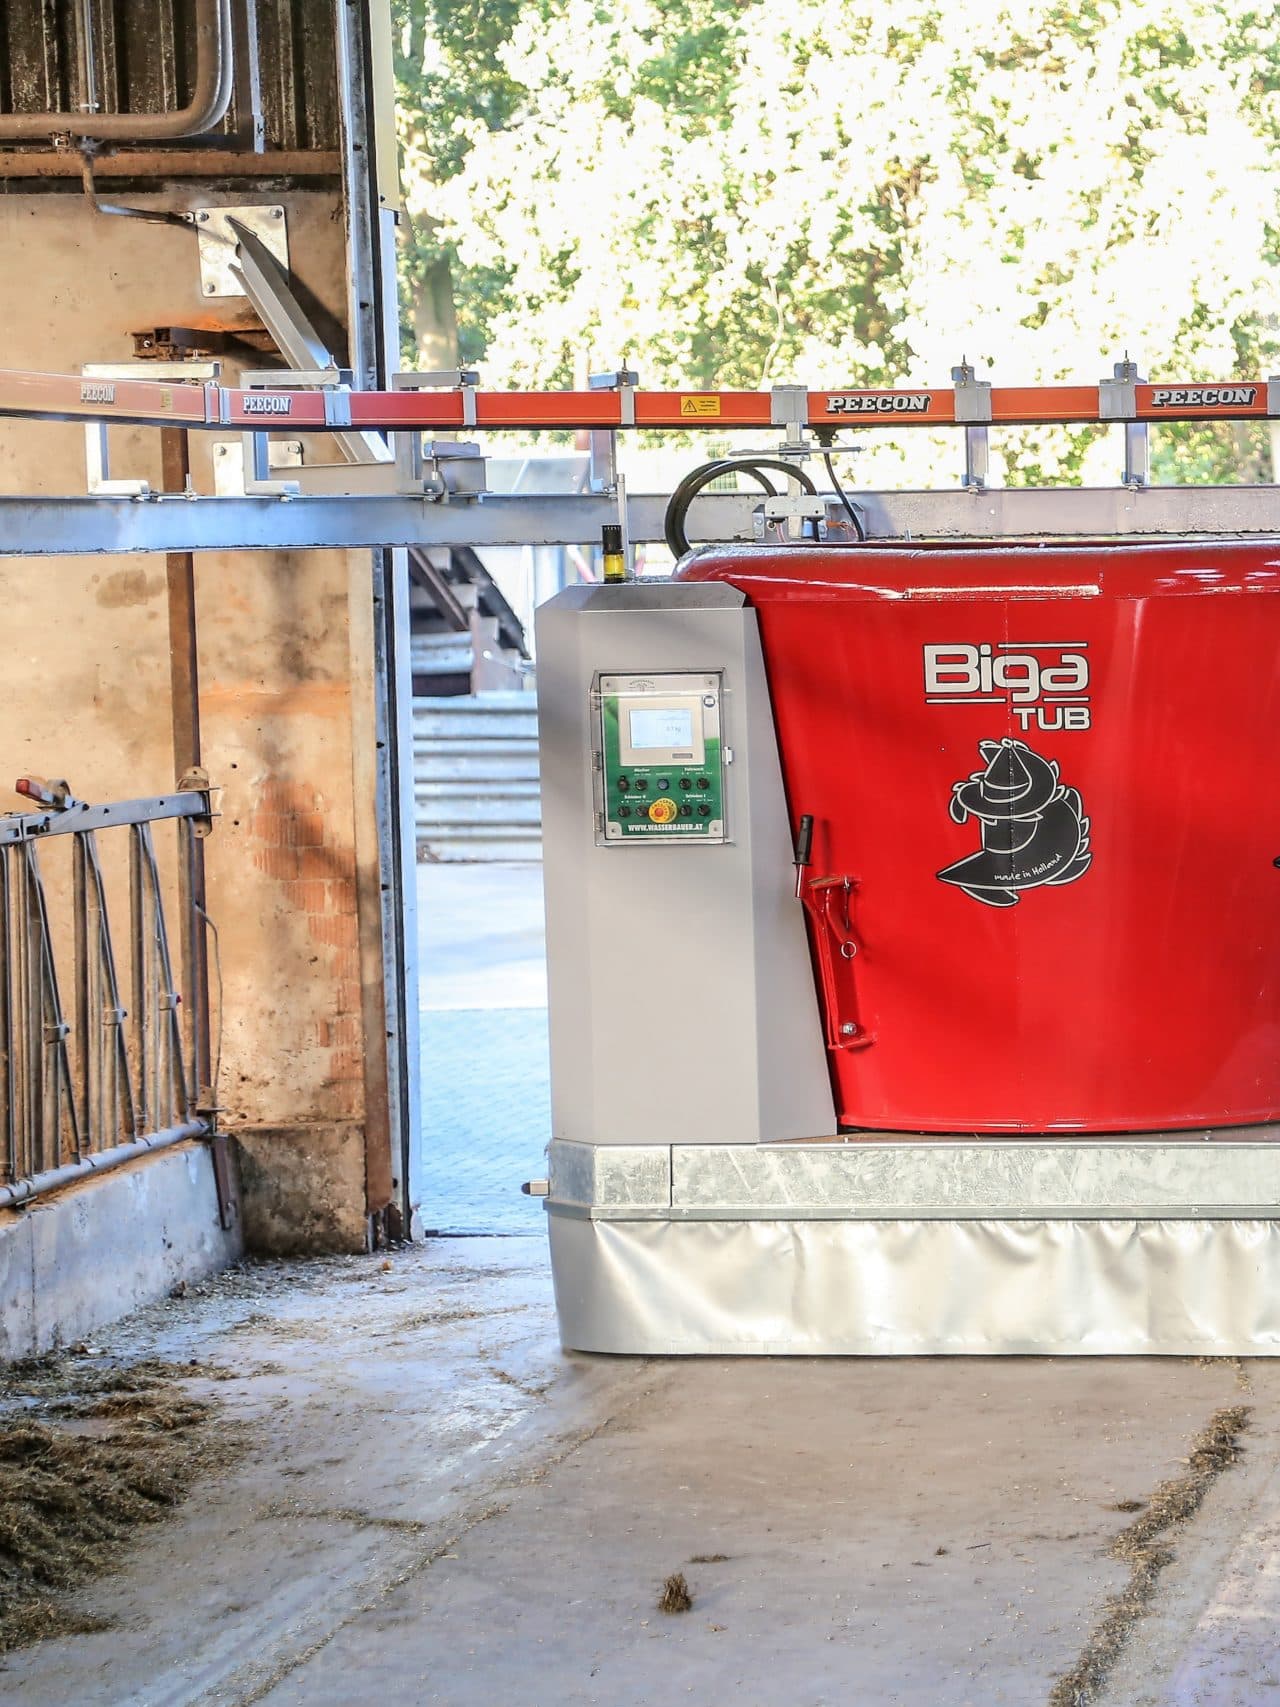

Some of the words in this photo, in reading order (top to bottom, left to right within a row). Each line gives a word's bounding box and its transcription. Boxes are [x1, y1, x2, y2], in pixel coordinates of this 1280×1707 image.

[80, 382, 115, 405] PEECON
[243, 396, 291, 413] PEECON
[826, 396, 930, 413] PEECON
[1152, 388, 1255, 406] PEECON
[923, 643, 1090, 703] Biga
[1012, 706, 1092, 731] TUB
[994, 872, 1021, 880] made
[1022, 870, 1032, 879] in
[1031, 853, 1063, 876] Holland
